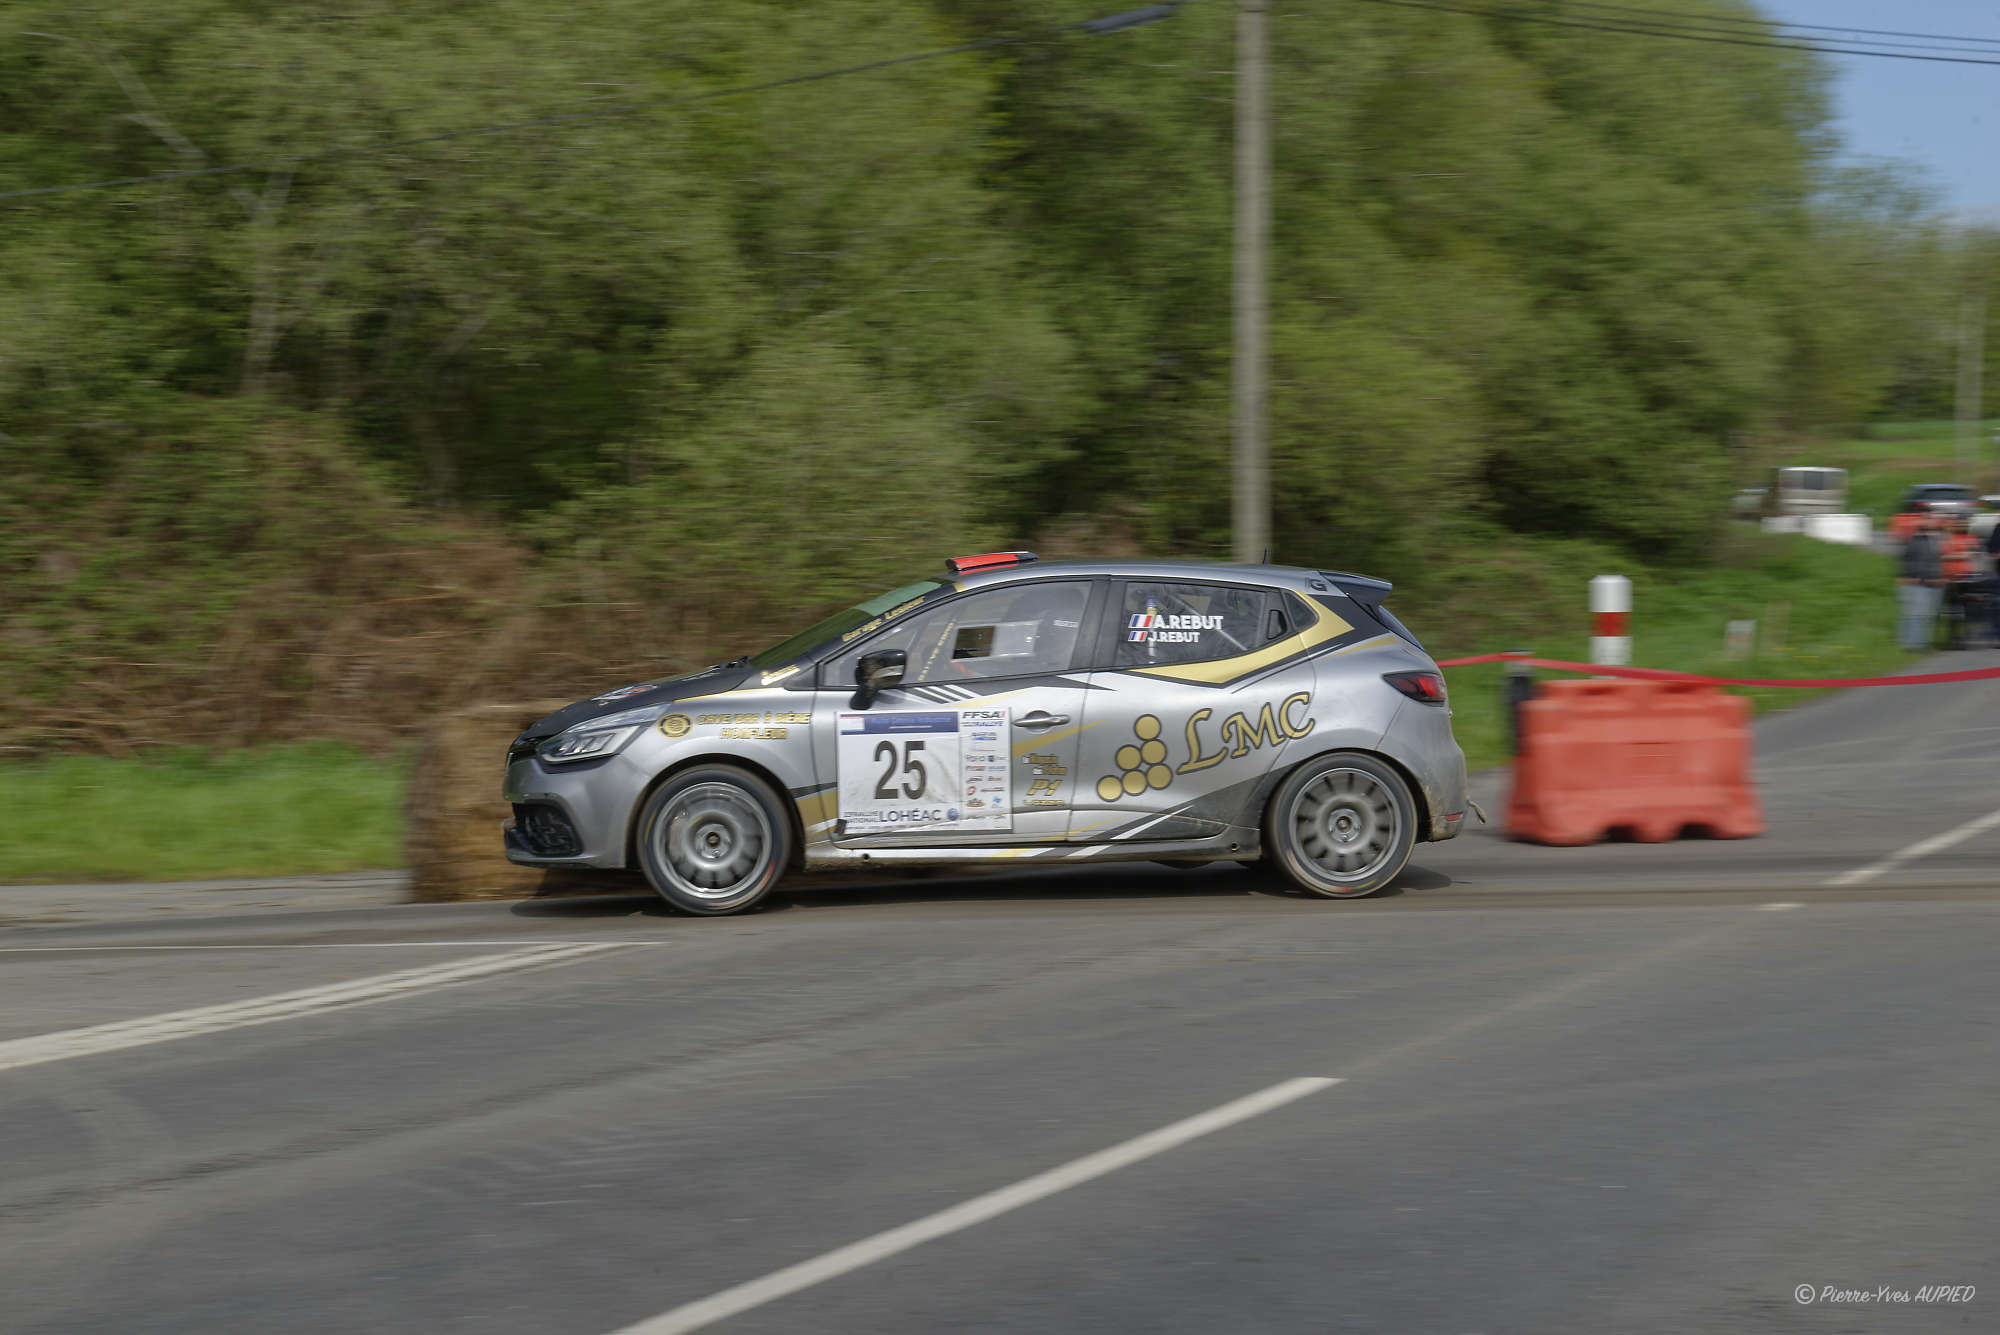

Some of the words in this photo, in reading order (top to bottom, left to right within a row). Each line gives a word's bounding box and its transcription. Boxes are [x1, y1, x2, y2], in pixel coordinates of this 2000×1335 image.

[1153, 614, 1224, 630] A.REBUT
[1147, 631, 1201, 643] J.REBUT
[962, 711, 1001, 719] FFSA
[1176, 691, 1315, 775] LMC
[874, 740, 927, 800] 25
[879, 808, 942, 823] LOHÉAC
